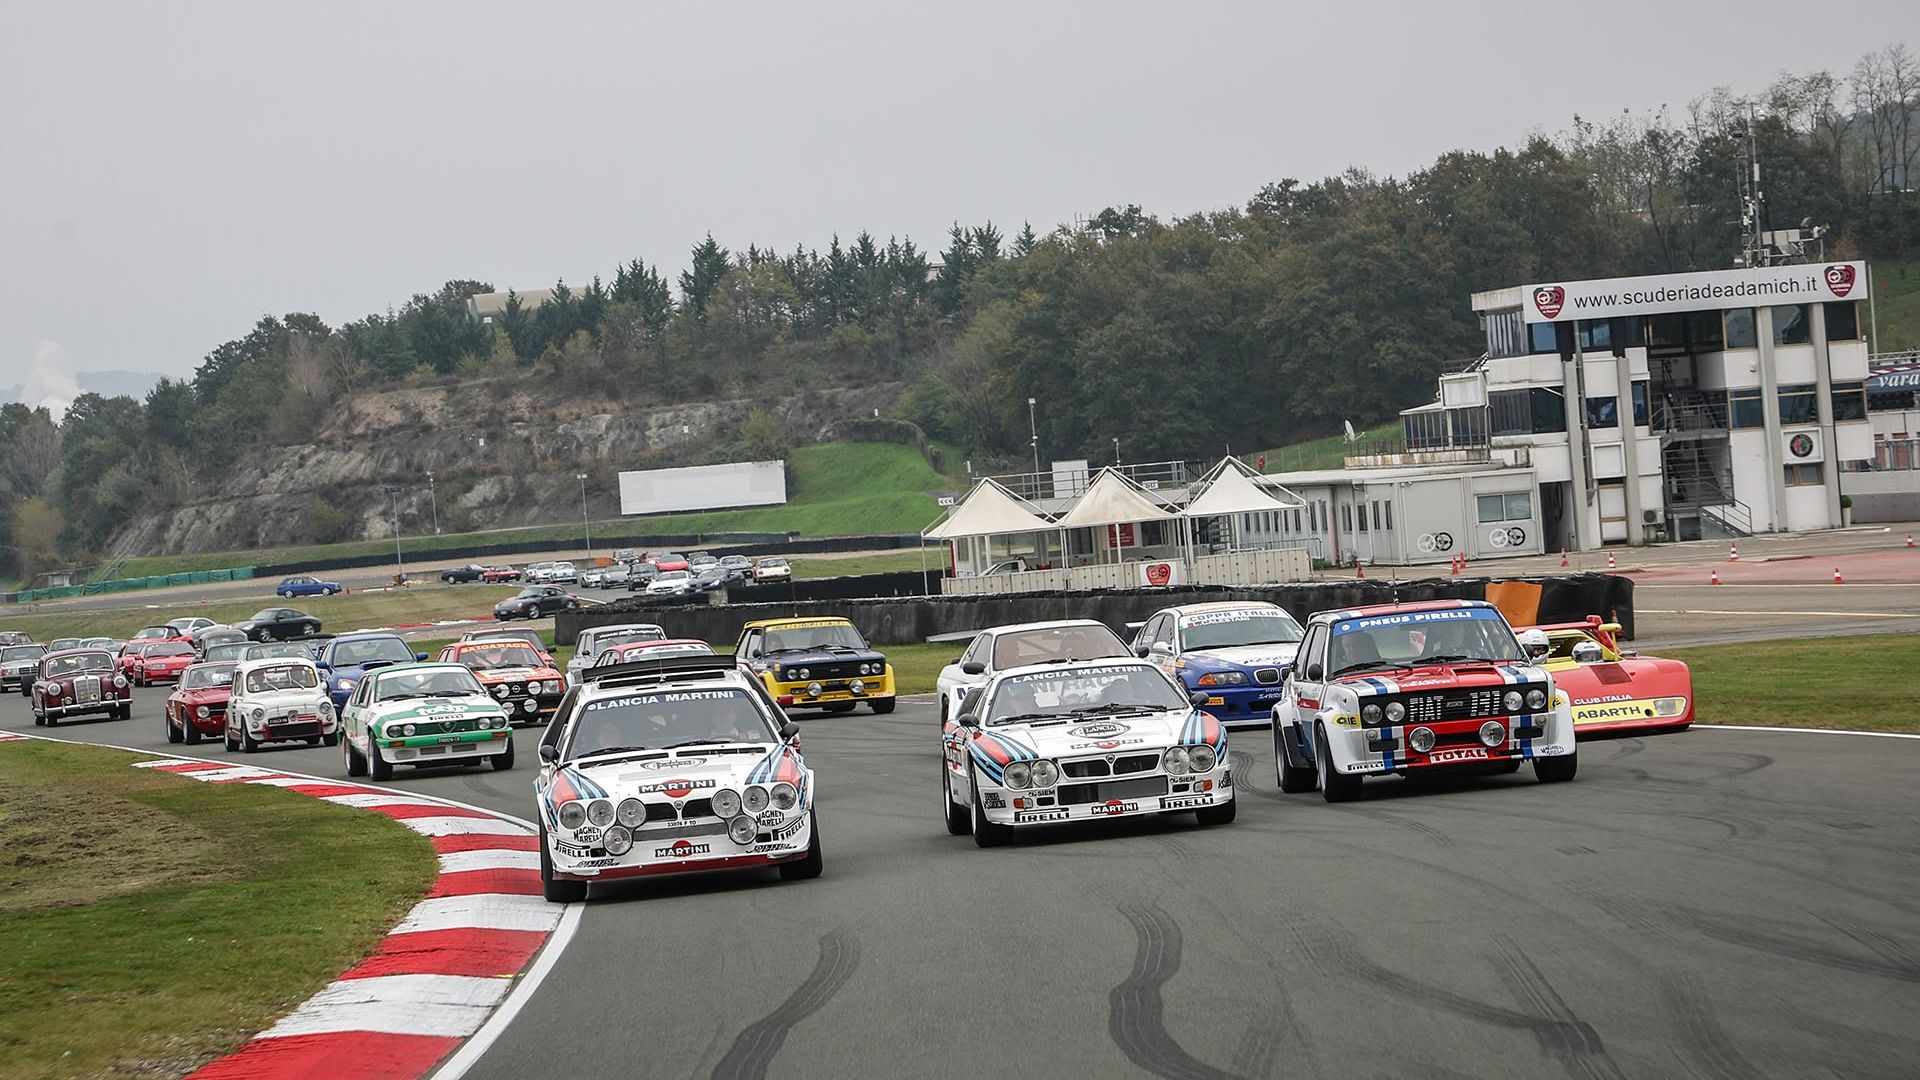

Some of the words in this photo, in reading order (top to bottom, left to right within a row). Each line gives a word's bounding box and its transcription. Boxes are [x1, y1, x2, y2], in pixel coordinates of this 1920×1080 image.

[1574, 276, 1818, 309] www.scuderiadeadamich.it
[1189, 612, 1232, 622] COPPA
[1360, 616, 1410, 628] PNEUS
[1414, 611, 1472, 621] PIRELLI
[1013, 671, 1071, 684] LANCIA
[1077, 666, 1143, 676] MARTINI
[597, 696, 659, 710] LANCIA
[665, 691, 734, 701] MARTINI
[1574, 697, 1601, 705] CLUB
[1602, 694, 1633, 703] ITALIA
[1409, 695, 1444, 722] FIAT
[1577, 706, 1641, 720] ABARTH
[1086, 725, 1116, 733] LANCIA
[1431, 749, 1487, 762] TOTAL
[641, 780, 713, 792] MARTINI
[1092, 803, 1137, 814] MARTINI
[1159, 793, 1214, 809] PIRELLI
[1014, 807, 1070, 822] PIRELLI
[772, 814, 805, 841] PIRELLI
[554, 839, 590, 857] PIRELLI
[656, 844, 710, 857] MARTINI
